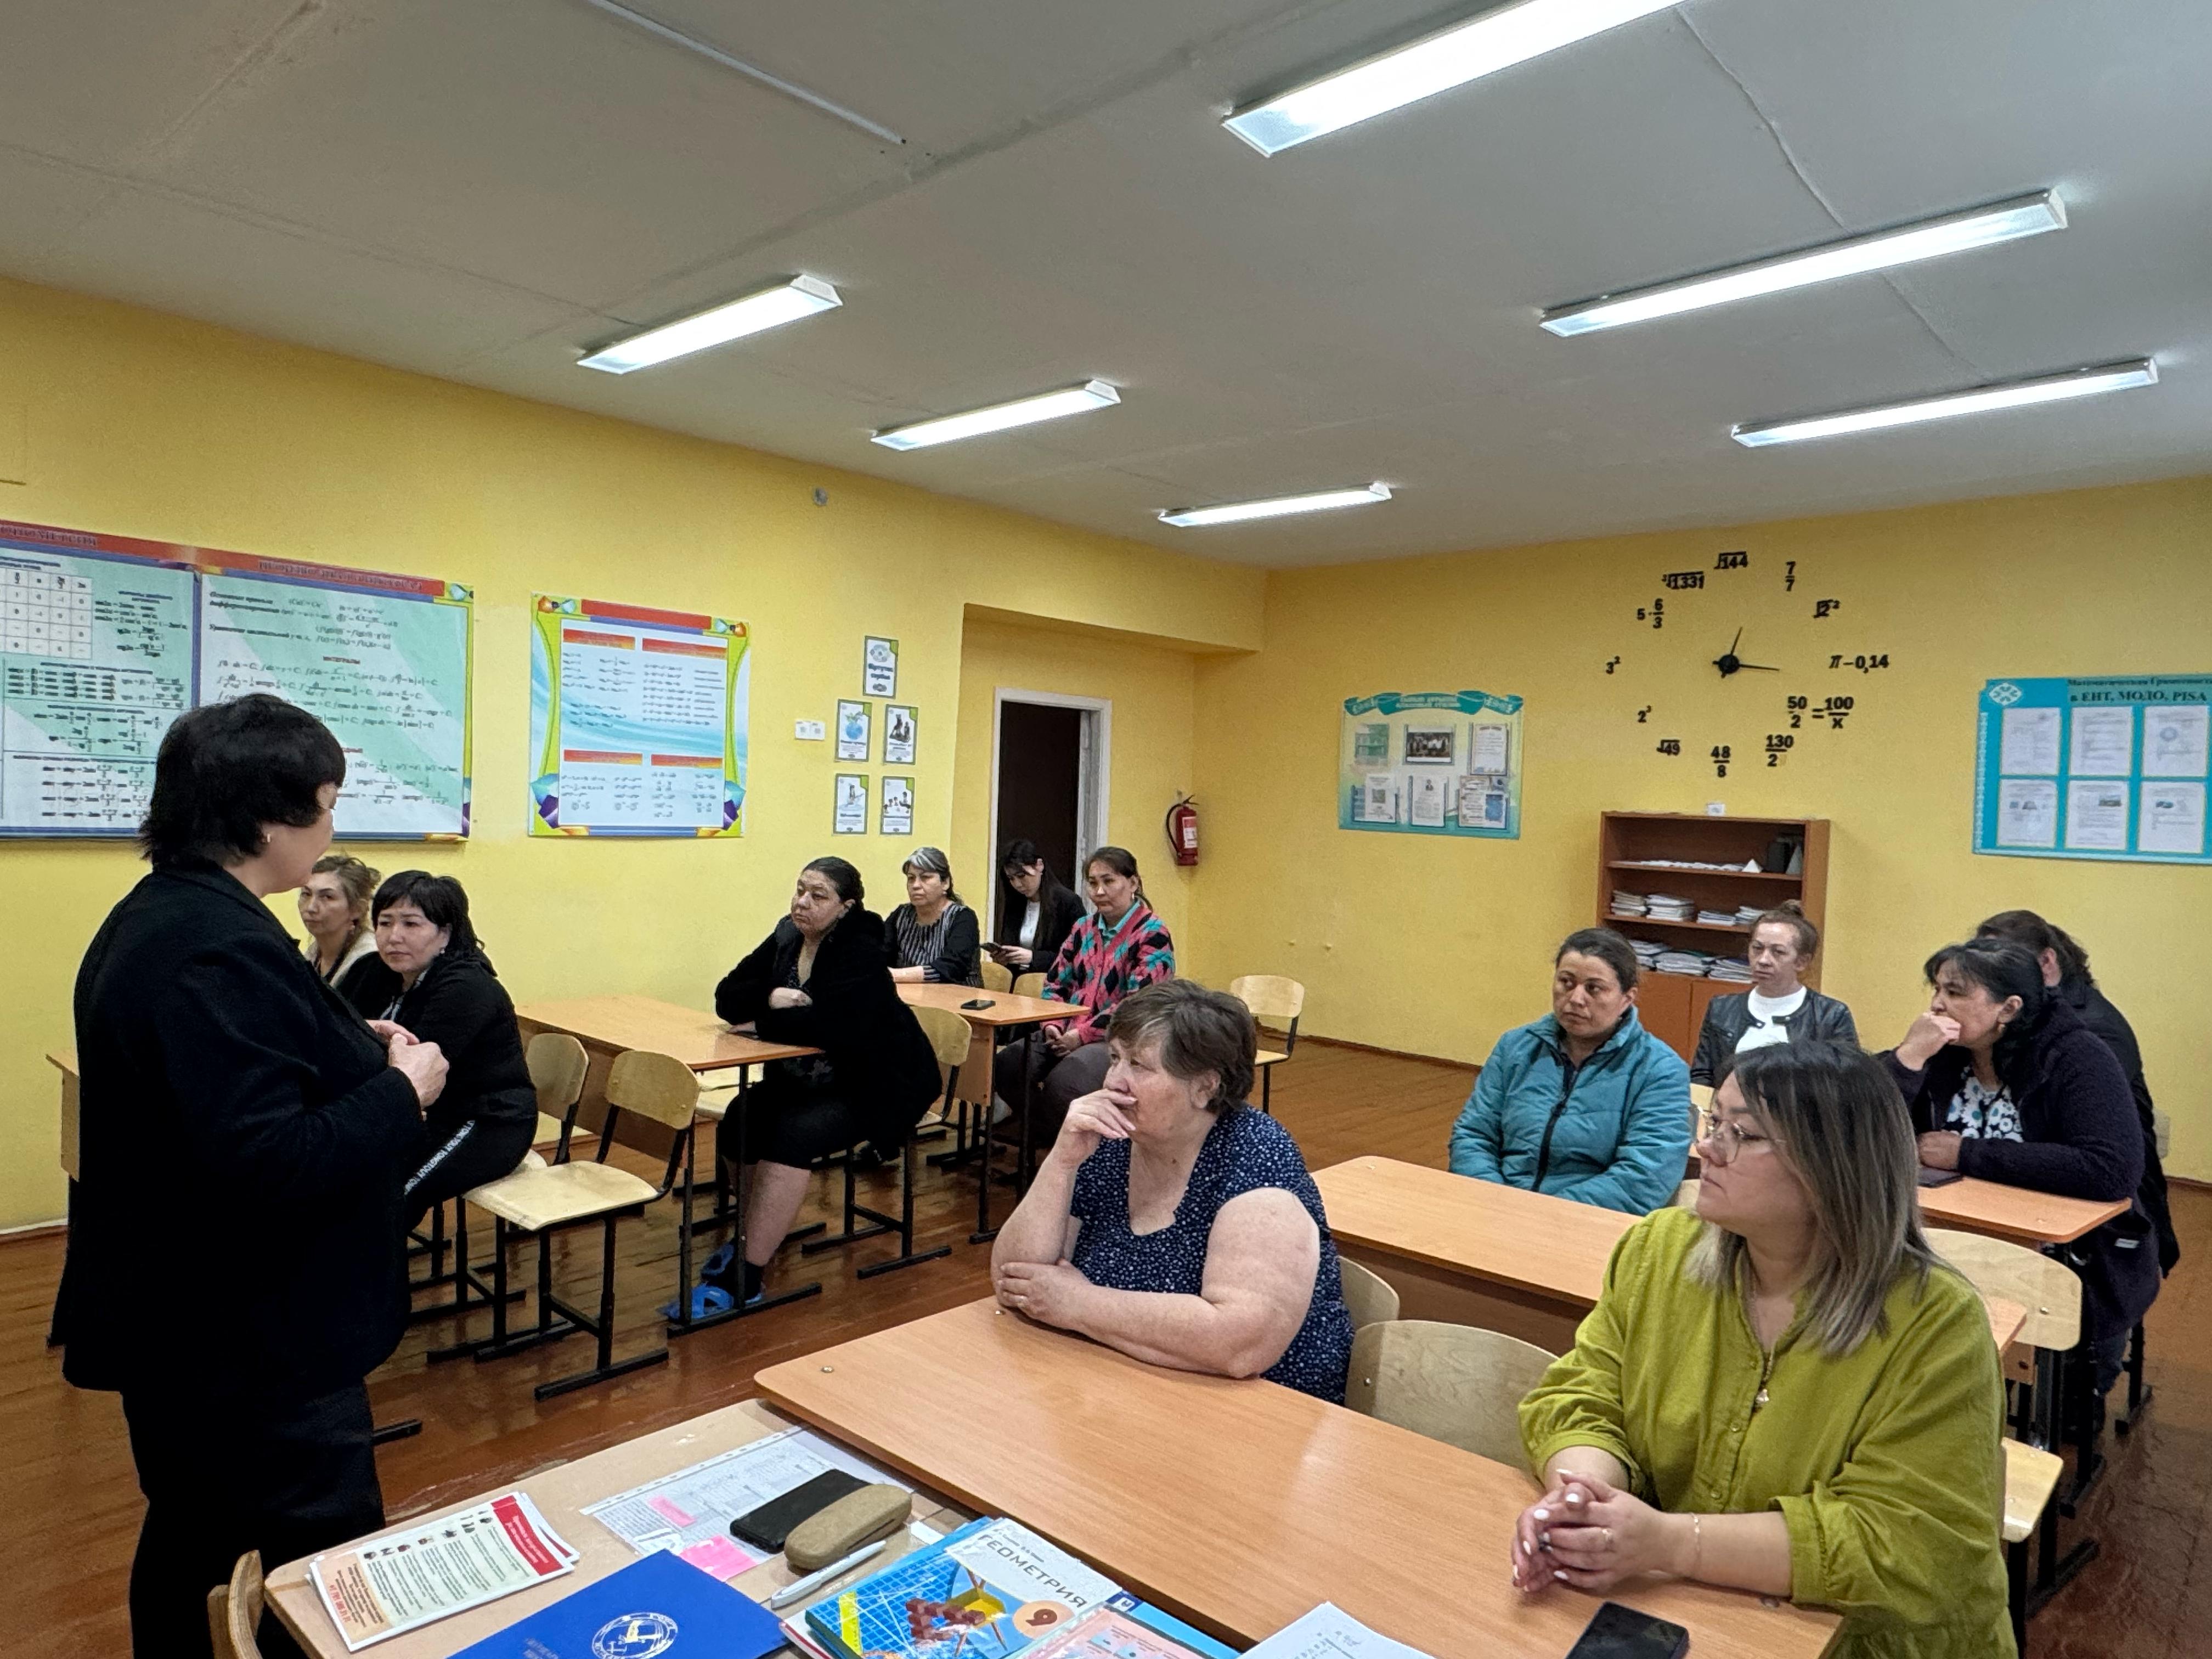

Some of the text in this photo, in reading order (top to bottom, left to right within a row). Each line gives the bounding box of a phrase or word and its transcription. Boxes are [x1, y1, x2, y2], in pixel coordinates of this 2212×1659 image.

[1787, 696, 1808, 709] 50
[1825, 696, 1854, 710] 100
[2172, 691, 2208, 702] PISA
[1765, 735, 1795, 748] 130
[1711, 746, 1731, 758] 48
[978, 1534, 1088, 1608] ГЕОМЕТРИЯ
[1025, 1608, 1058, 1626] 9
